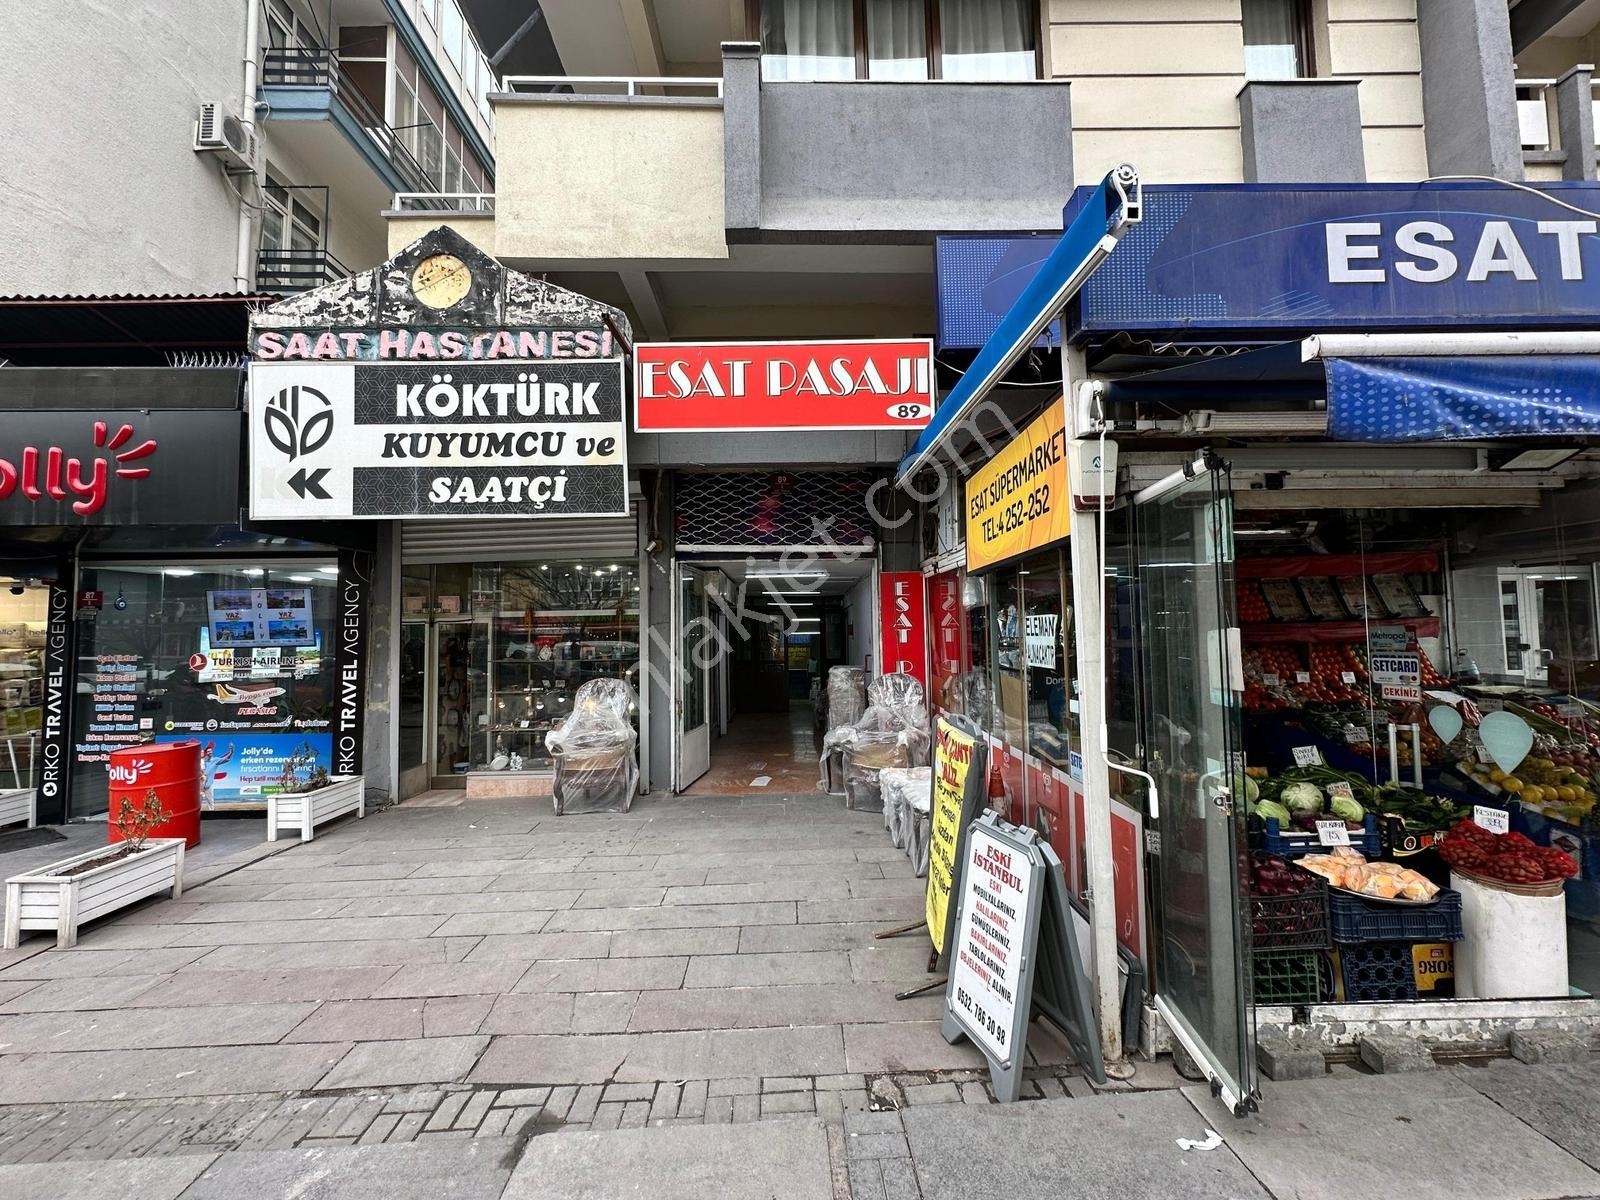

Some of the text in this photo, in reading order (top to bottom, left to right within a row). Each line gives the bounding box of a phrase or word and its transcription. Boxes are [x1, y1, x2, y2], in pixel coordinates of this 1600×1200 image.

[1326, 222, 1597, 283] ESAT
[257, 331, 368, 359] SAAT
[396, 373, 601, 417] KÖKTÜRK
[640, 356, 929, 398] ESAT PASAJI
[897, 404, 921, 418] 89
[381, 432, 615, 458] KUYUMCU ve
[428, 469, 569, 508] SAATÇİ
[971, 426, 1067, 519] ESAT SÜPERMARKET
[50, 586, 67, 661] AGENCY
[344, 580, 360, 654] AGENCY
[1026, 616, 1055, 637] ELEMAN
[212, 656, 305, 666] TURKISH AIRLINES
[1373, 660, 1418, 673] SETCARD
[46, 666, 63, 738] TRAVEL
[340, 660, 358, 731] TRAVEL
[1071, 753, 1083, 770] SETC
[973, 849, 1024, 894] İSTANBUL
[986, 844, 1012, 870] ESKİ
